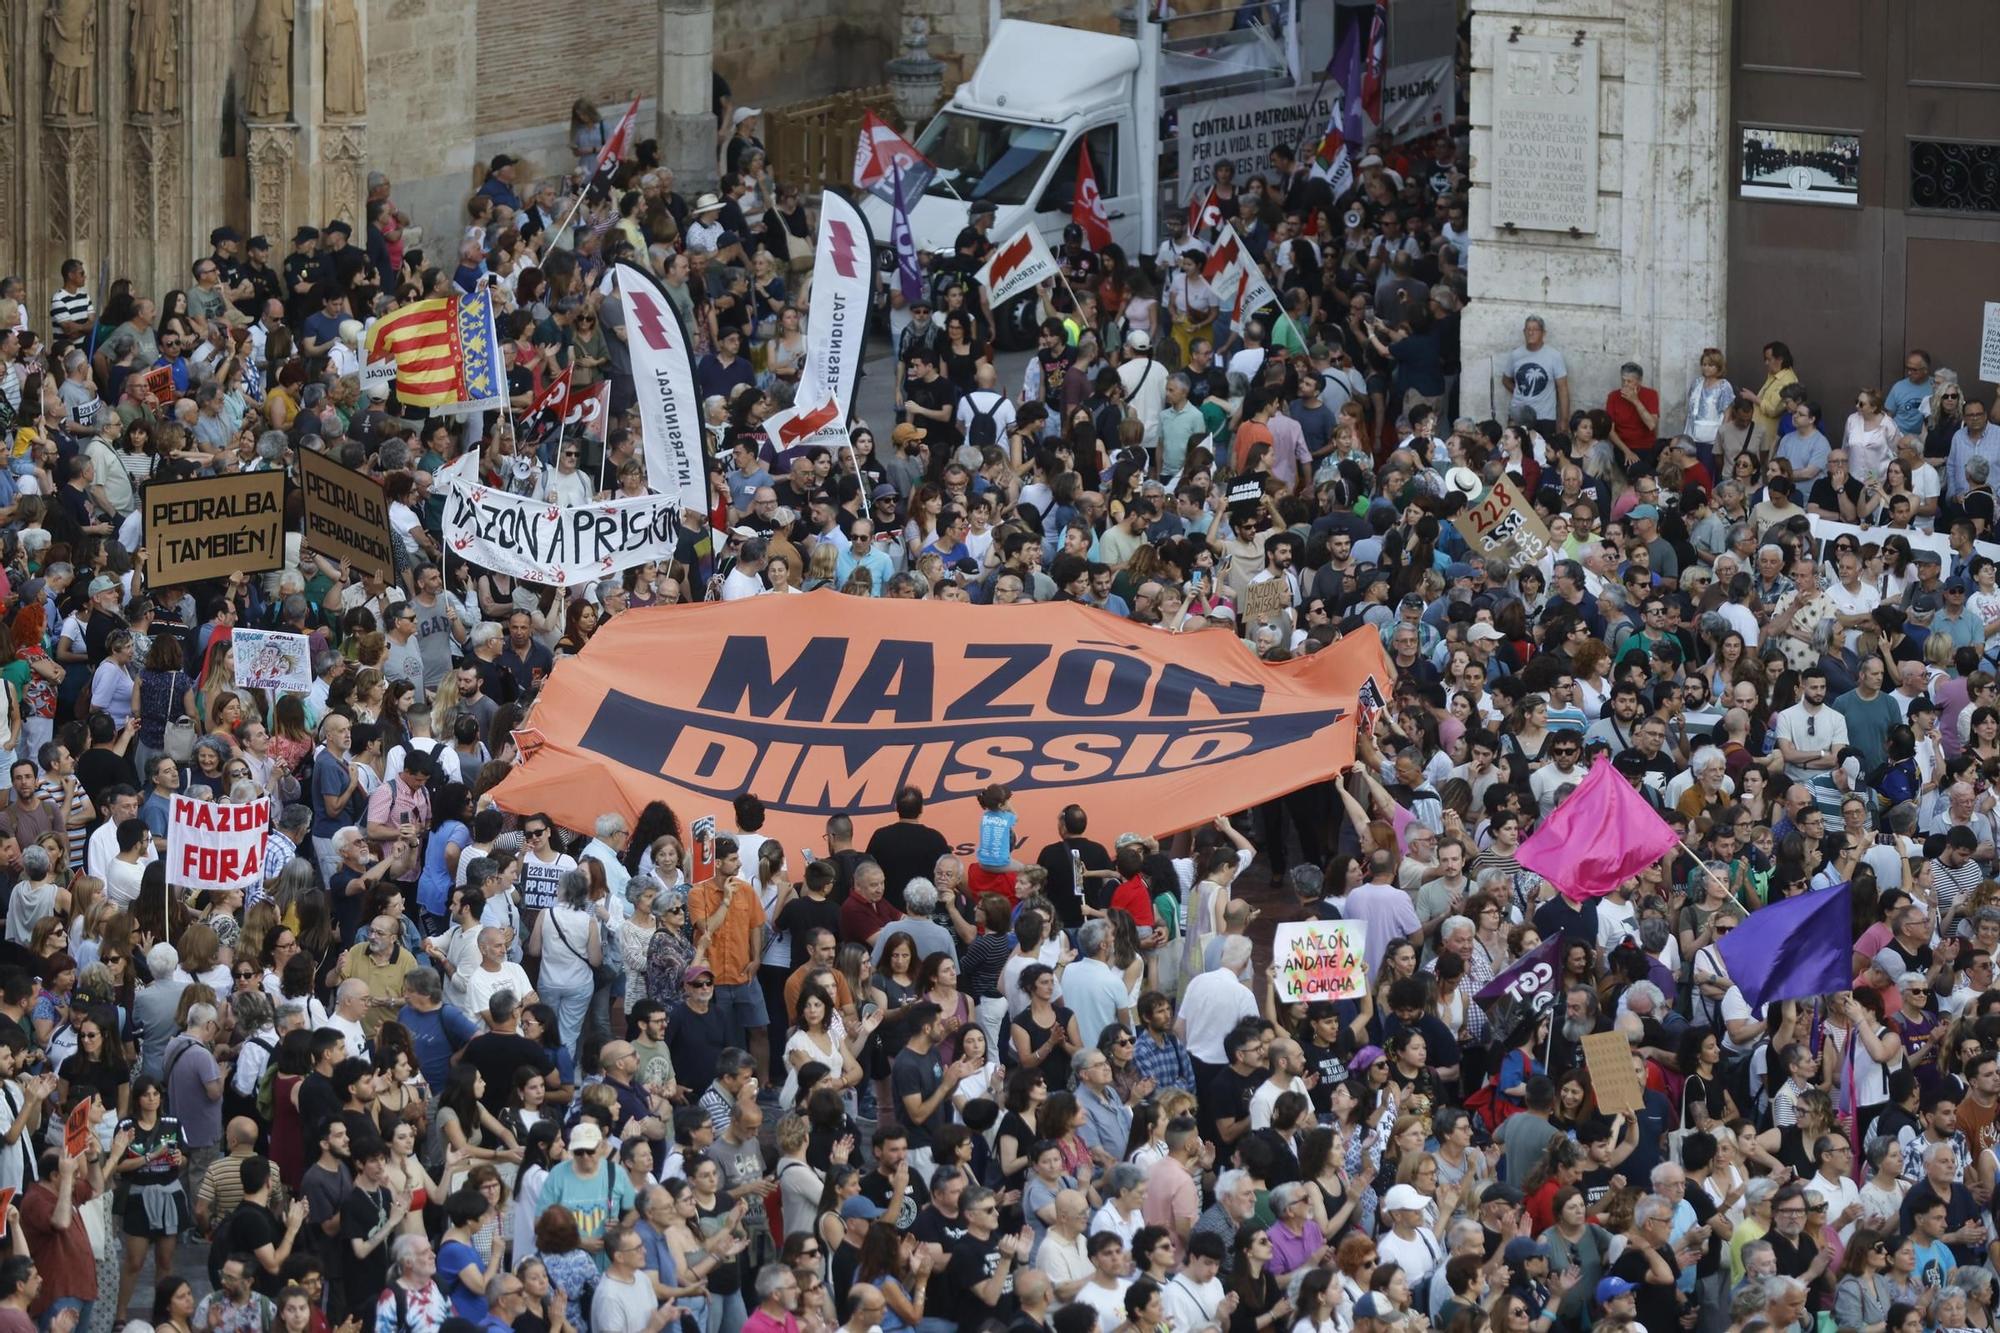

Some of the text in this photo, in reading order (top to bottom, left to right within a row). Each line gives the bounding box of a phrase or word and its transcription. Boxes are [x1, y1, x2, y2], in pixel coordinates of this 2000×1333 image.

[1192, 115, 1236, 138] CONTRA
[1238, 113, 1253, 130] LA
[1254, 103, 1307, 127] PATRONAL
[1318, 99, 1331, 115] EL
[1192, 143, 1212, 161] PER
[1214, 141, 1227, 155] LA
[1257, 133, 1269, 148] EL
[1504, 143, 1541, 157] JOAN
[1192, 165, 1210, 184] ELS
[1469, 482, 1512, 534] 228
[452, 486, 541, 562] MAZÓN
[157, 522, 278, 574] ¡TAMBIÉN!
[308, 511, 391, 566] REPARACIÓN
[522, 569, 545, 582] 228
[421, 615, 451, 638] GAP
[697, 634, 1265, 724] MAZÓN
[659, 720, 1255, 809] DIMISSIÓ
[183, 831, 269, 884] FORA!
[528, 866, 543, 877] 228
[525, 880, 537, 892] PP
[1291, 929, 1350, 951] MAZÓN
[1343, 953, 1355, 968] A
[1287, 976, 1356, 995] LA CHUCHA
